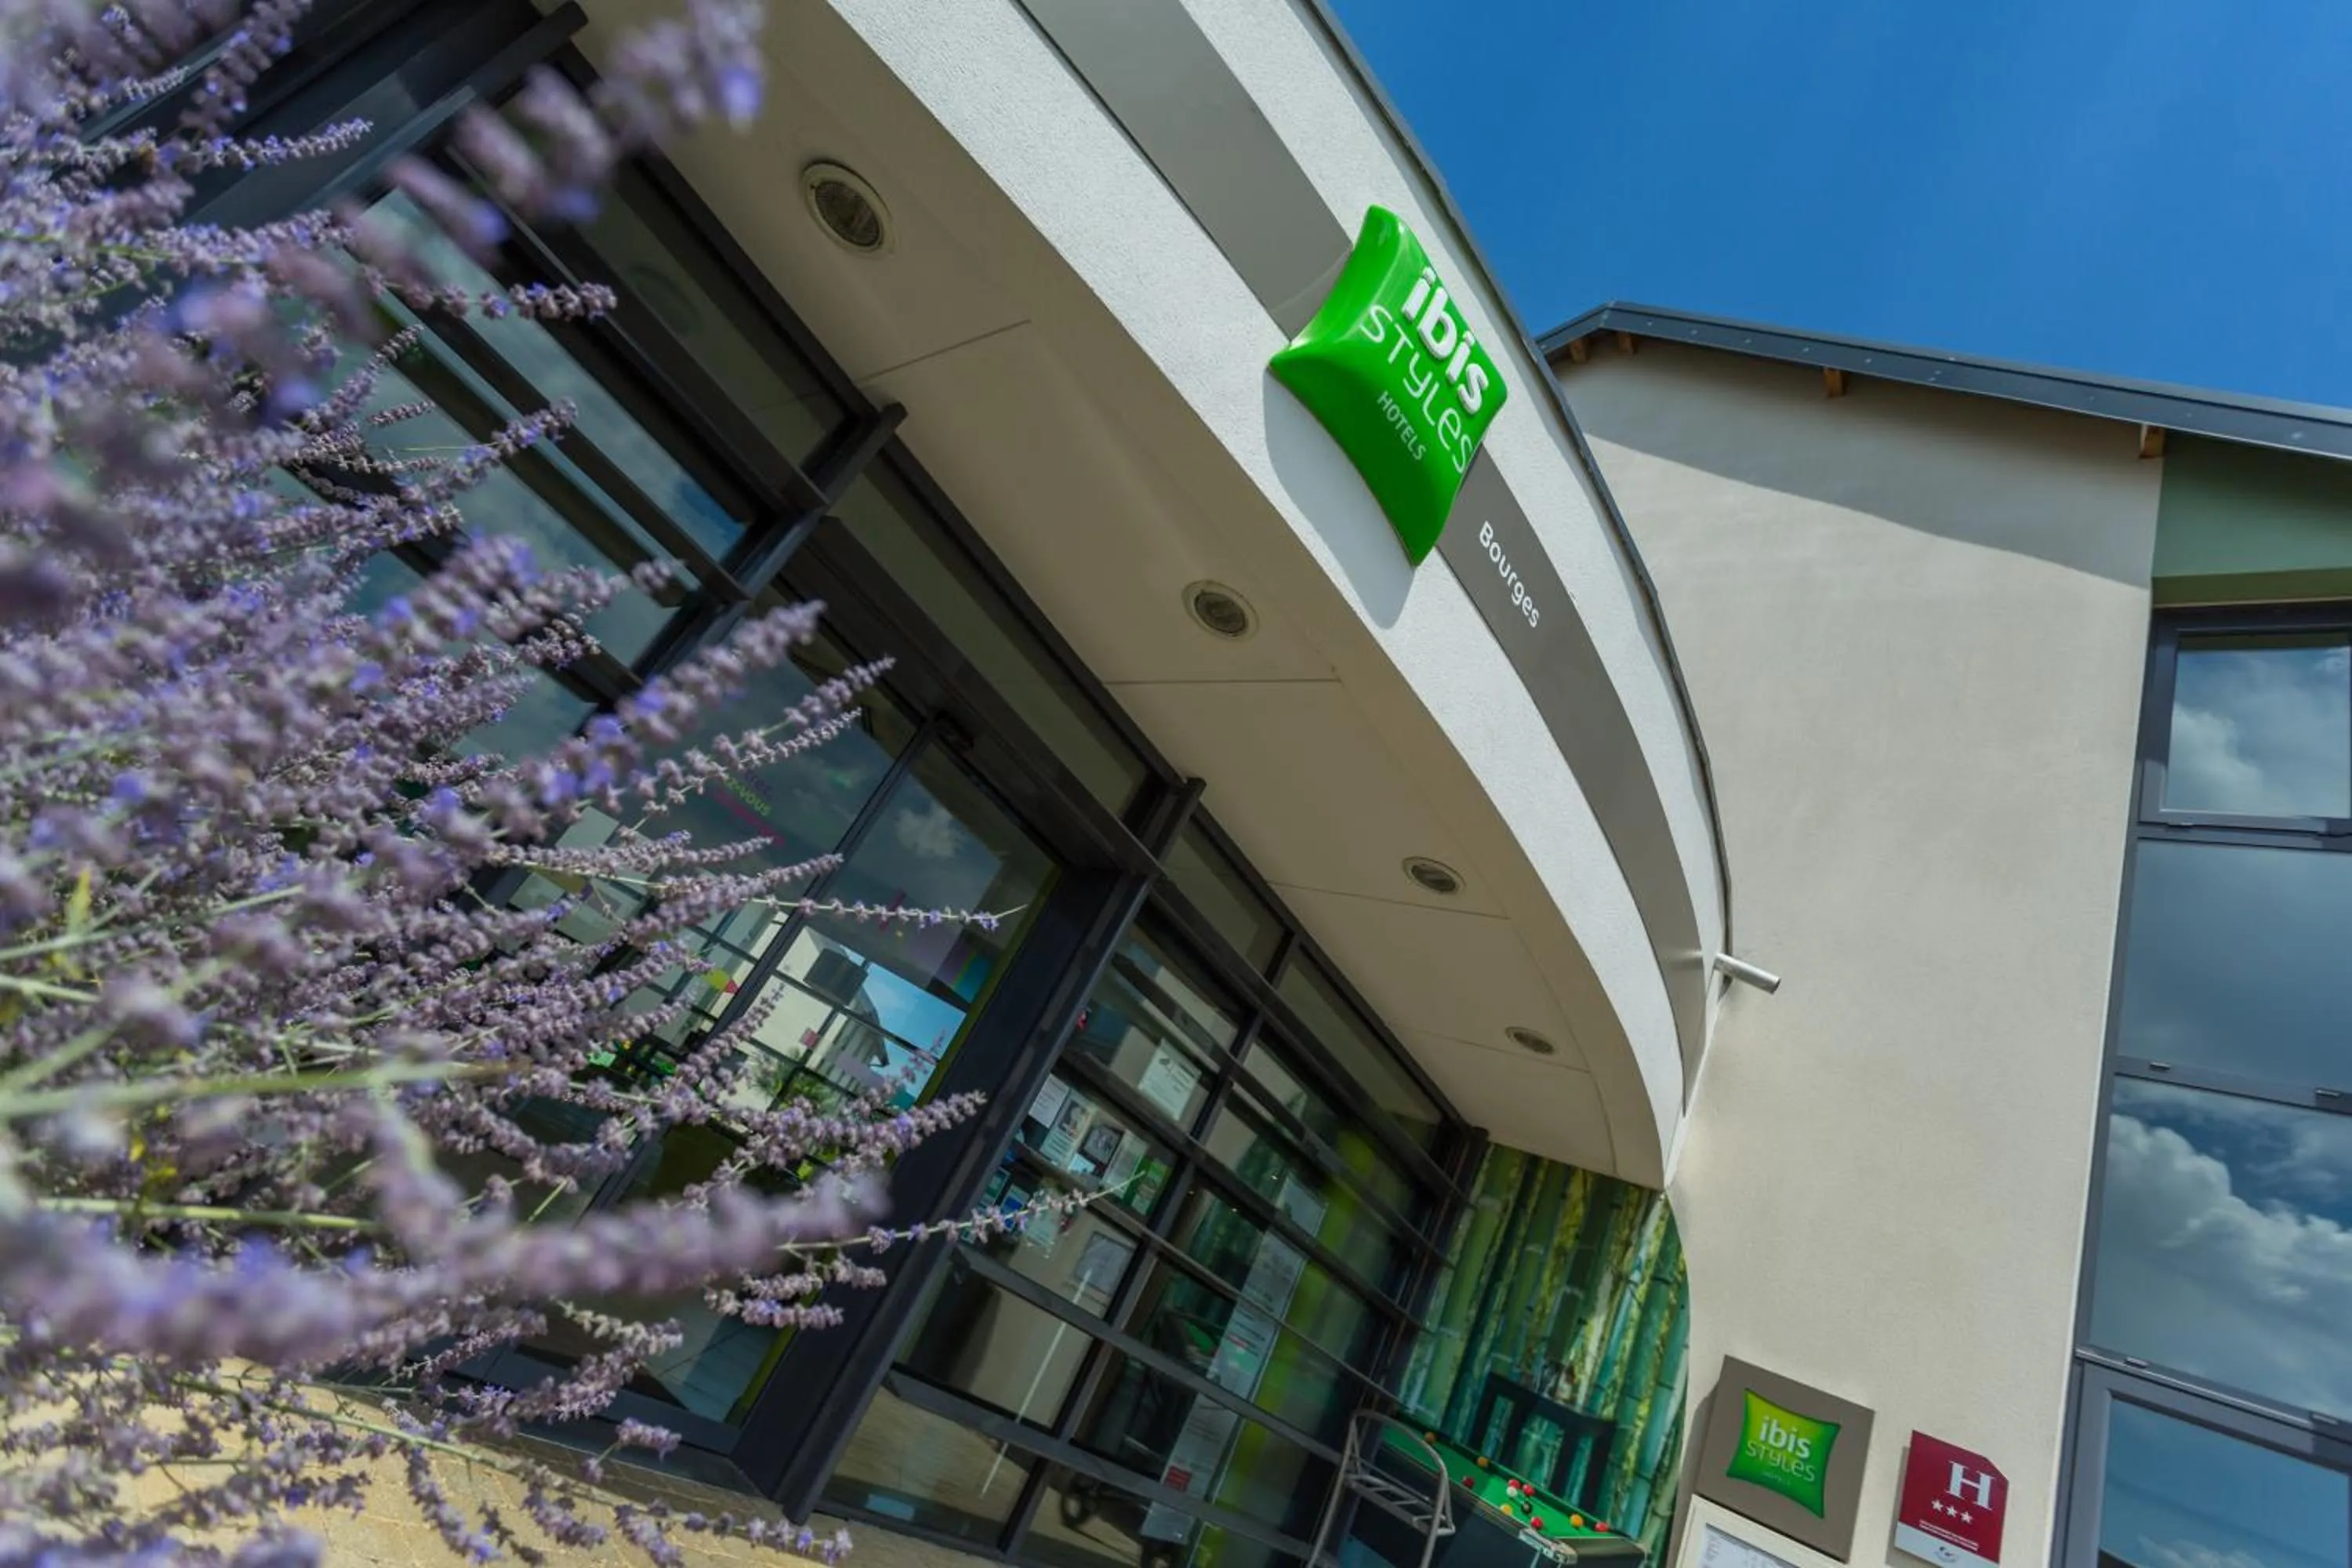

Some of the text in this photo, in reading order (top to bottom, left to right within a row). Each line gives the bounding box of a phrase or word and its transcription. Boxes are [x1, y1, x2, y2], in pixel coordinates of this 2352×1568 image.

[1401, 267, 1489, 415] ibis
[1377, 390, 1427, 462] HOTELS
[1479, 520, 1540, 628] Bourges
[1759, 1414, 1812, 1459] ibis
[1945, 1460, 1995, 1512] H
